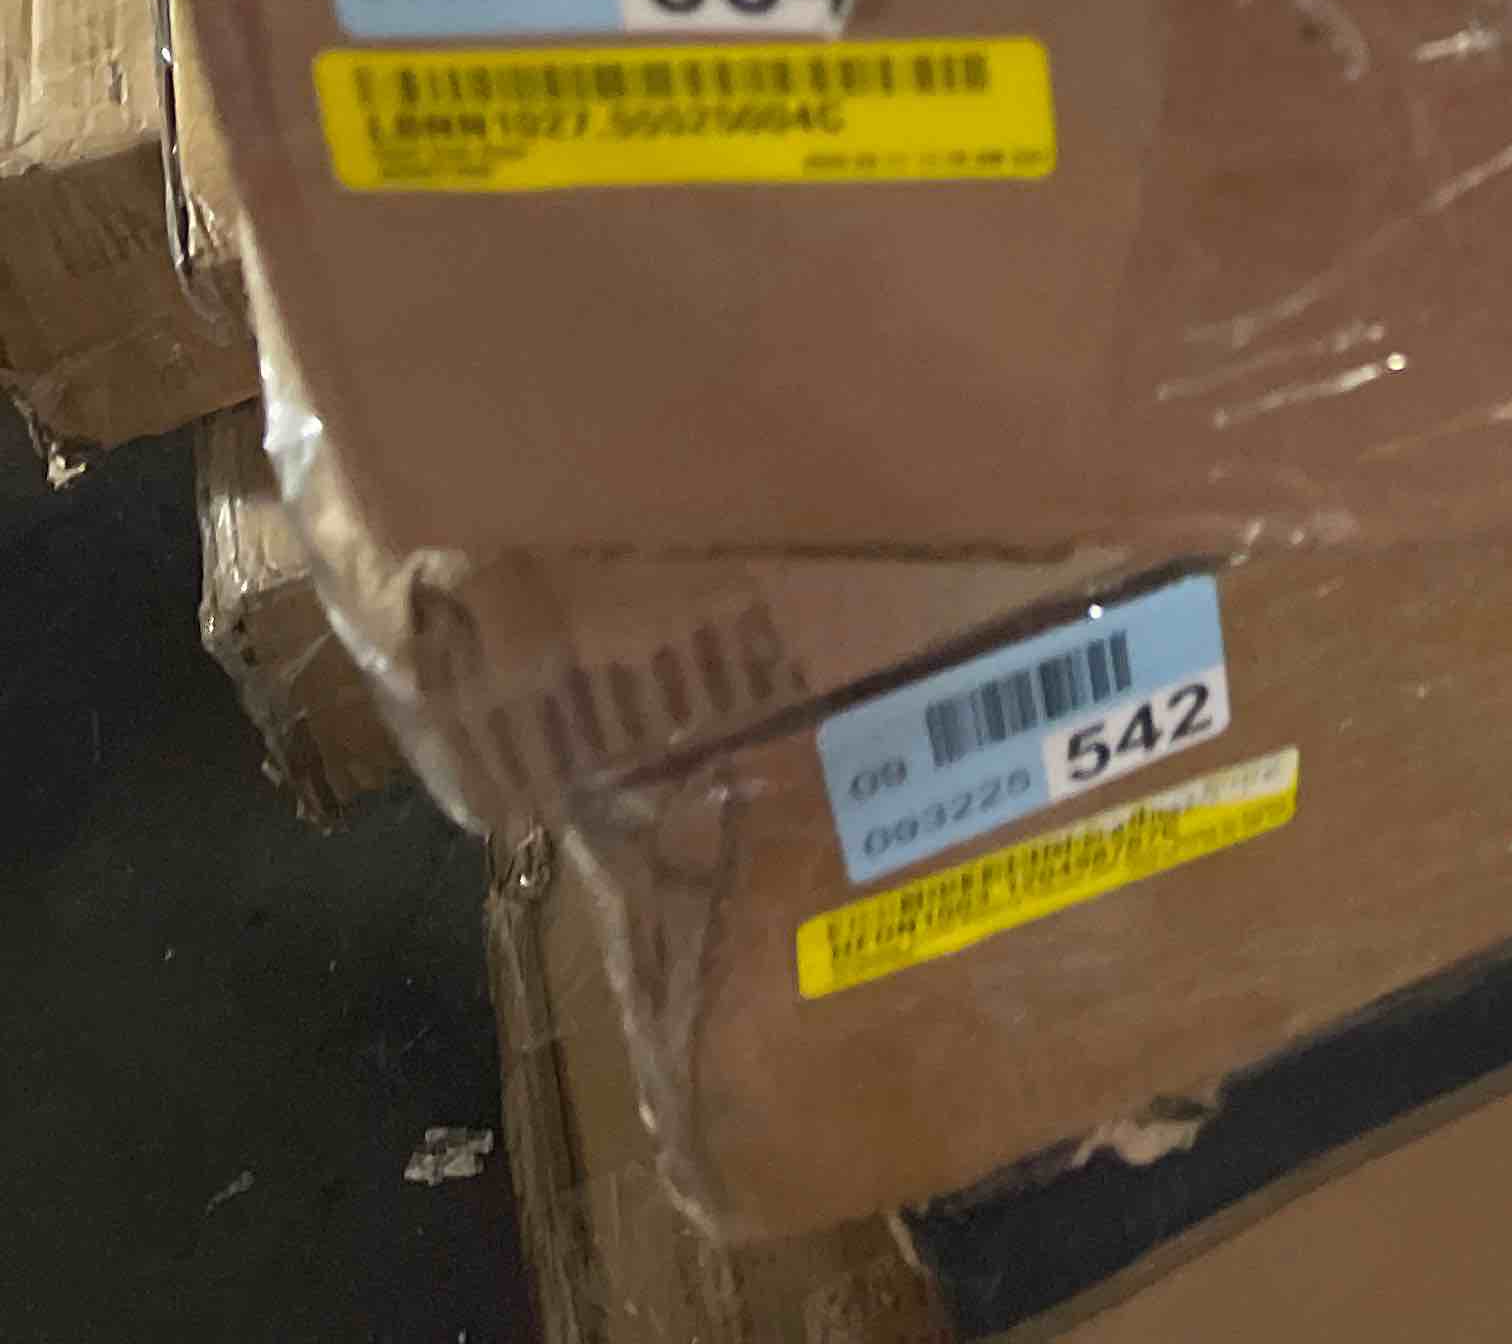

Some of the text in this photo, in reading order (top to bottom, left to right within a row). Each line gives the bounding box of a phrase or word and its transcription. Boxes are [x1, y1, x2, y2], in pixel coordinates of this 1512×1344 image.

[847, 759, 908, 802] 09
[862, 682, 1214, 858] 093225 542
